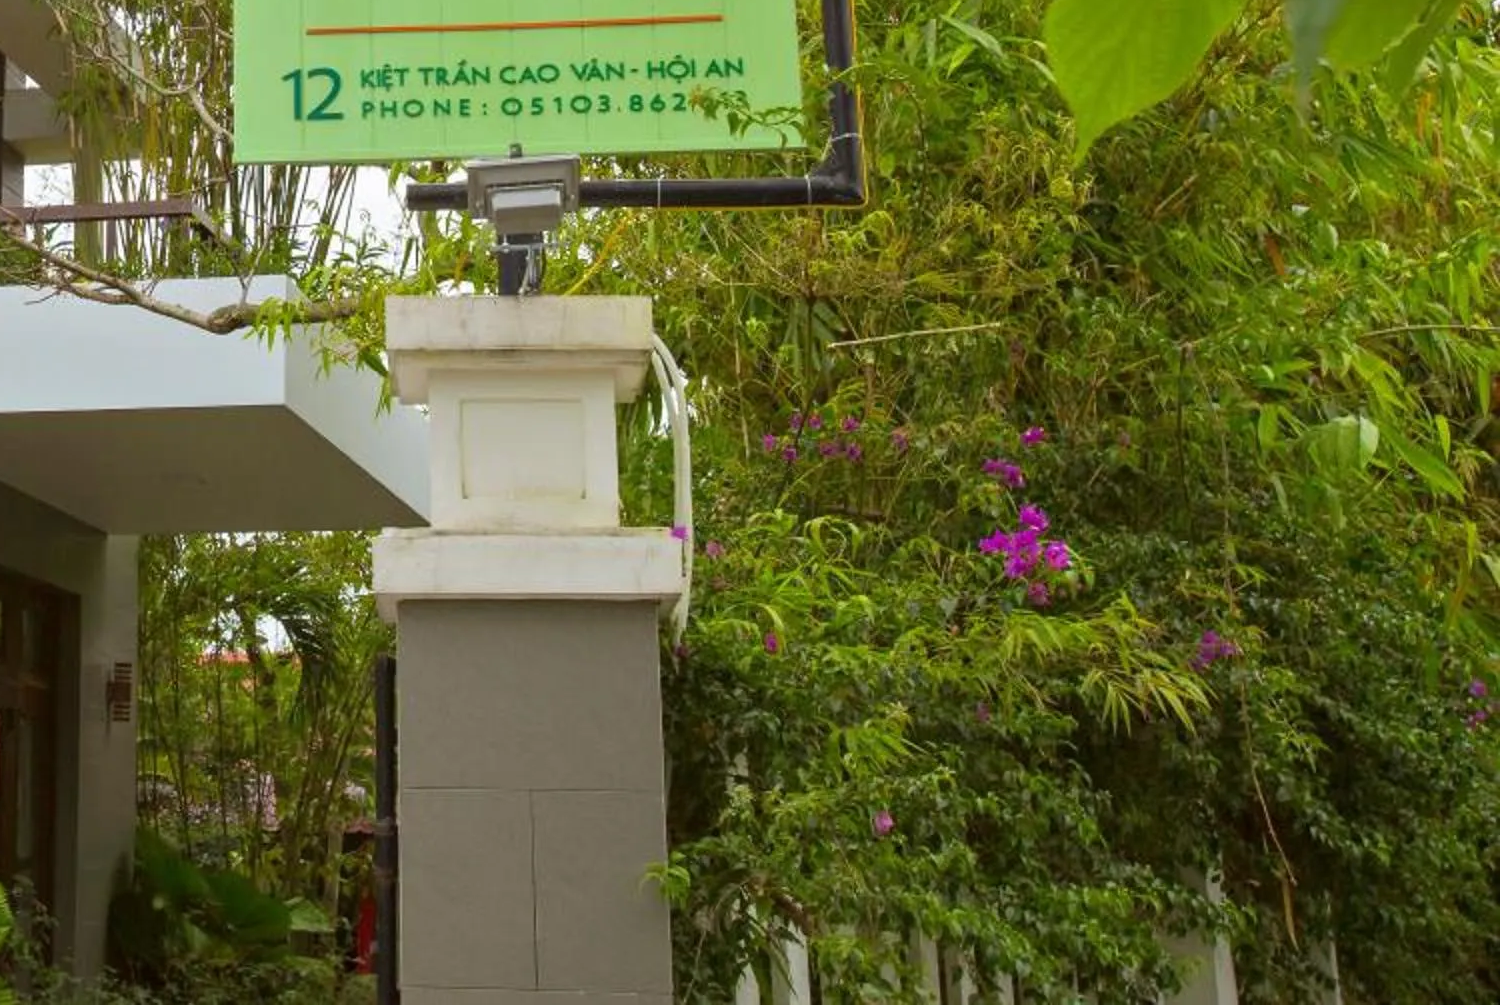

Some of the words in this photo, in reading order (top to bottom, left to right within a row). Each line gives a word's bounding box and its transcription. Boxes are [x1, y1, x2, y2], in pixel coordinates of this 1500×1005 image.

[499, 63, 561, 85] CAO
[646, 54, 697, 84] HỘI
[705, 57, 744, 79] AN
[282, 67, 344, 122] 12
